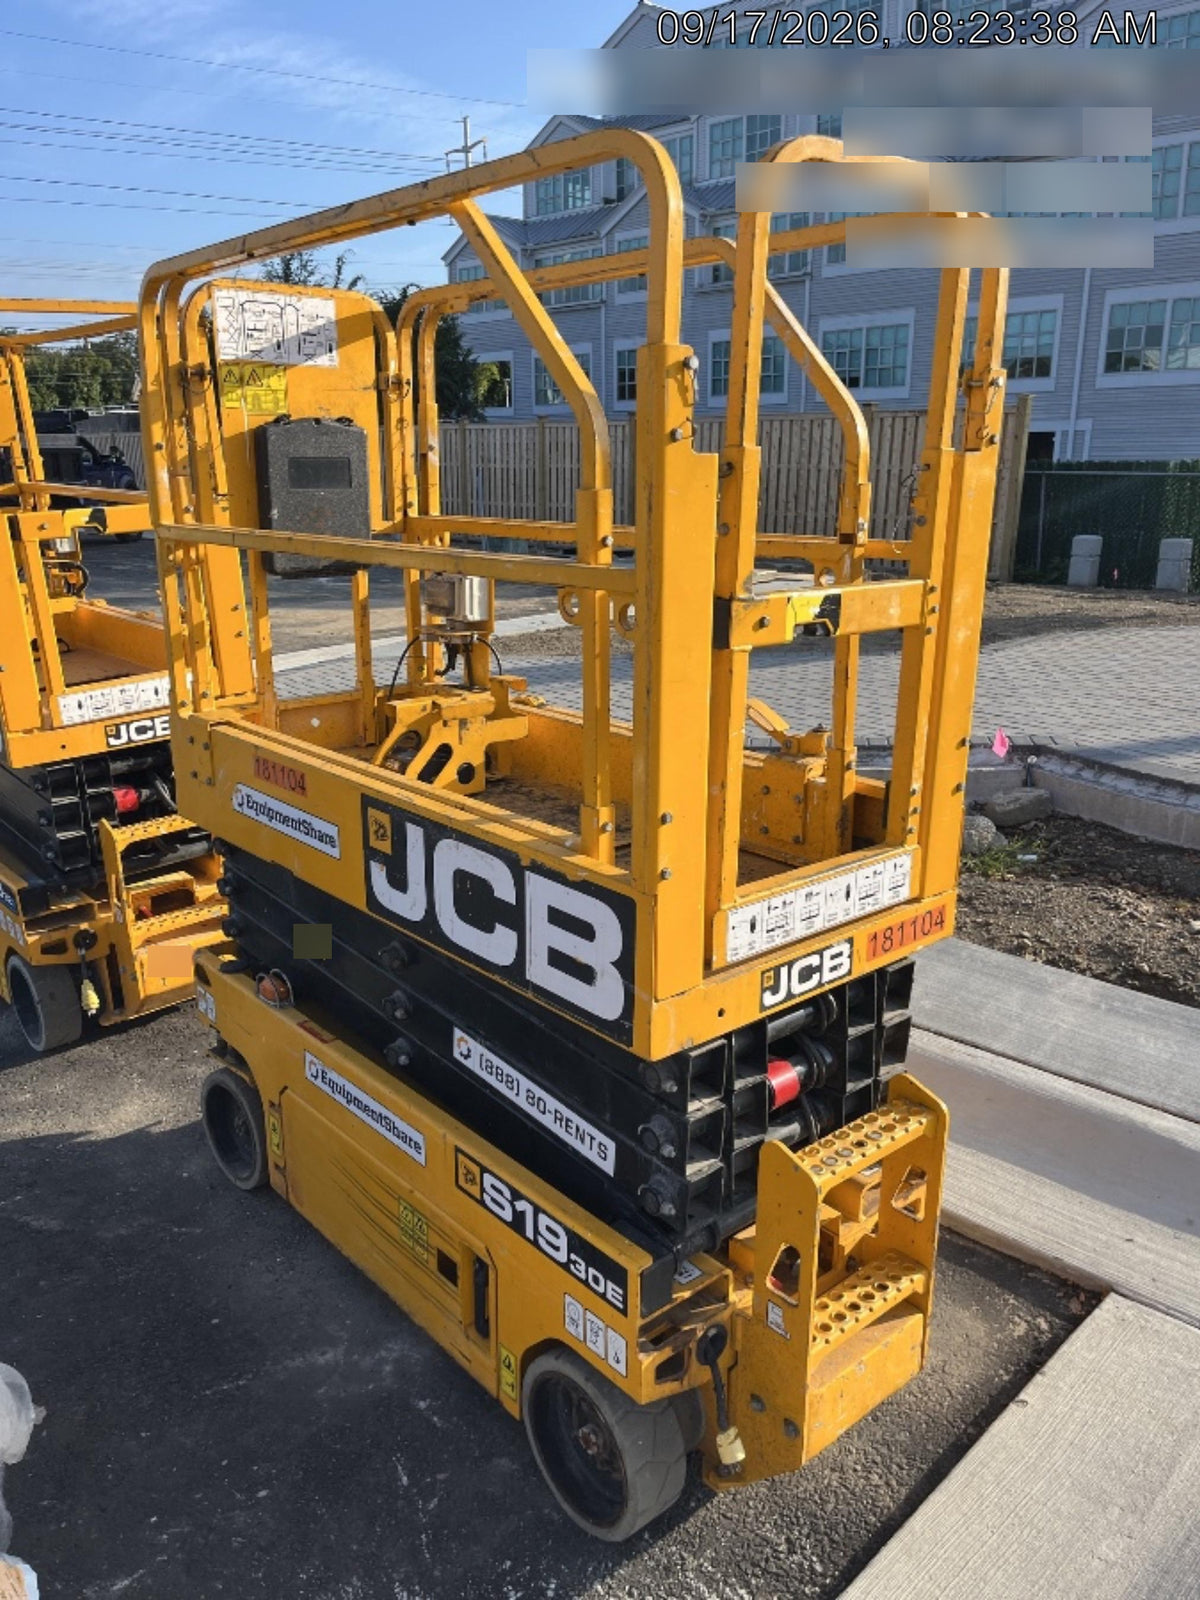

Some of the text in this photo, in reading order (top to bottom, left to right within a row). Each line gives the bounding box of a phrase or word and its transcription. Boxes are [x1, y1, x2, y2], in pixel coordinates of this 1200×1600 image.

[254, 757, 306, 794] 181104
[245, 793, 337, 849] EquipmentShare
[369, 821, 625, 1022] JCB
[870, 905, 946, 957] 181104
[762, 942, 851, 1007] JCB
[320, 1068, 423, 1155] EquipmentShare
[525, 1088, 609, 1162] 80-RENTS
